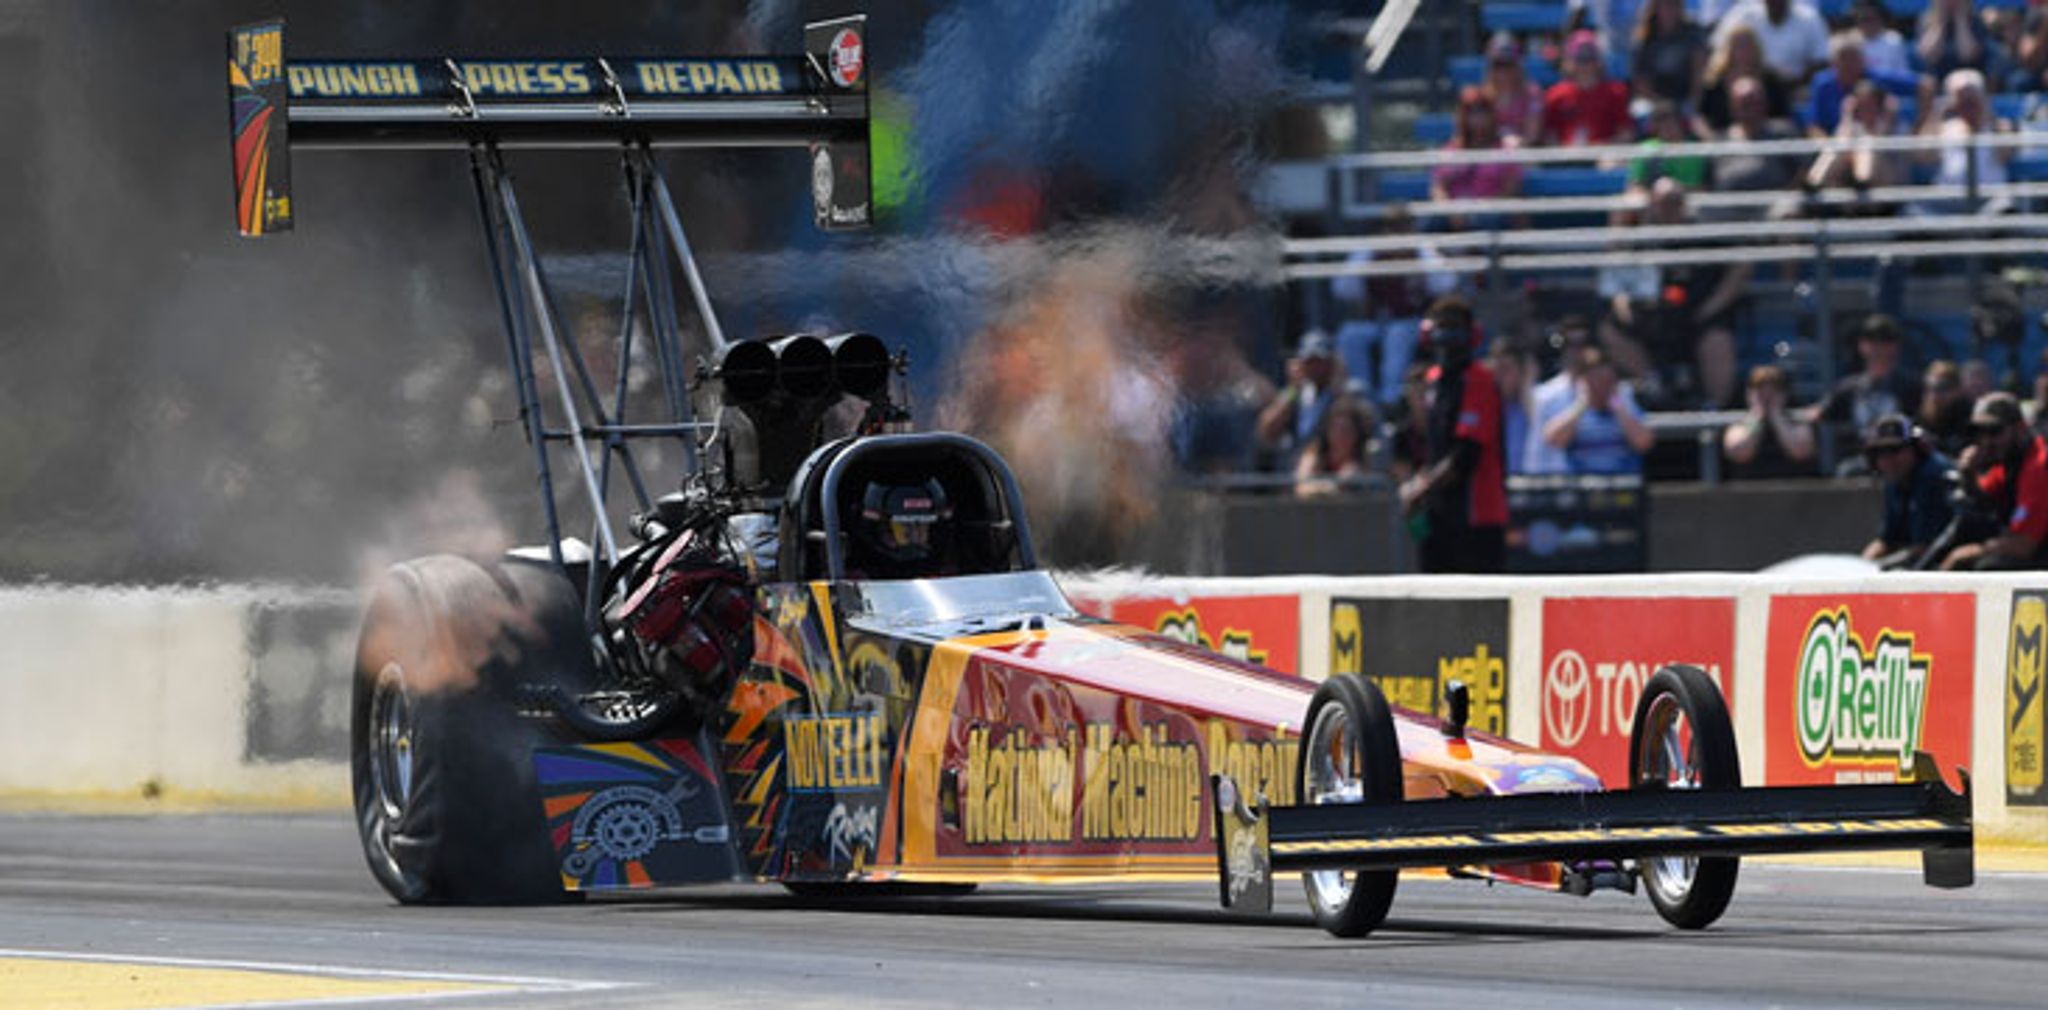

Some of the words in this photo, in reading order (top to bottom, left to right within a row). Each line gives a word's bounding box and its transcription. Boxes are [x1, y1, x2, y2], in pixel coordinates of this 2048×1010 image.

[287, 66, 419, 95] PUNCH
[465, 62, 592, 93] PRESS
[637, 62, 783, 92] REPAIR
[1800, 618, 1926, 770] O'Reilly
[965, 726, 1075, 842] National
[1083, 722, 1199, 838] Machine
